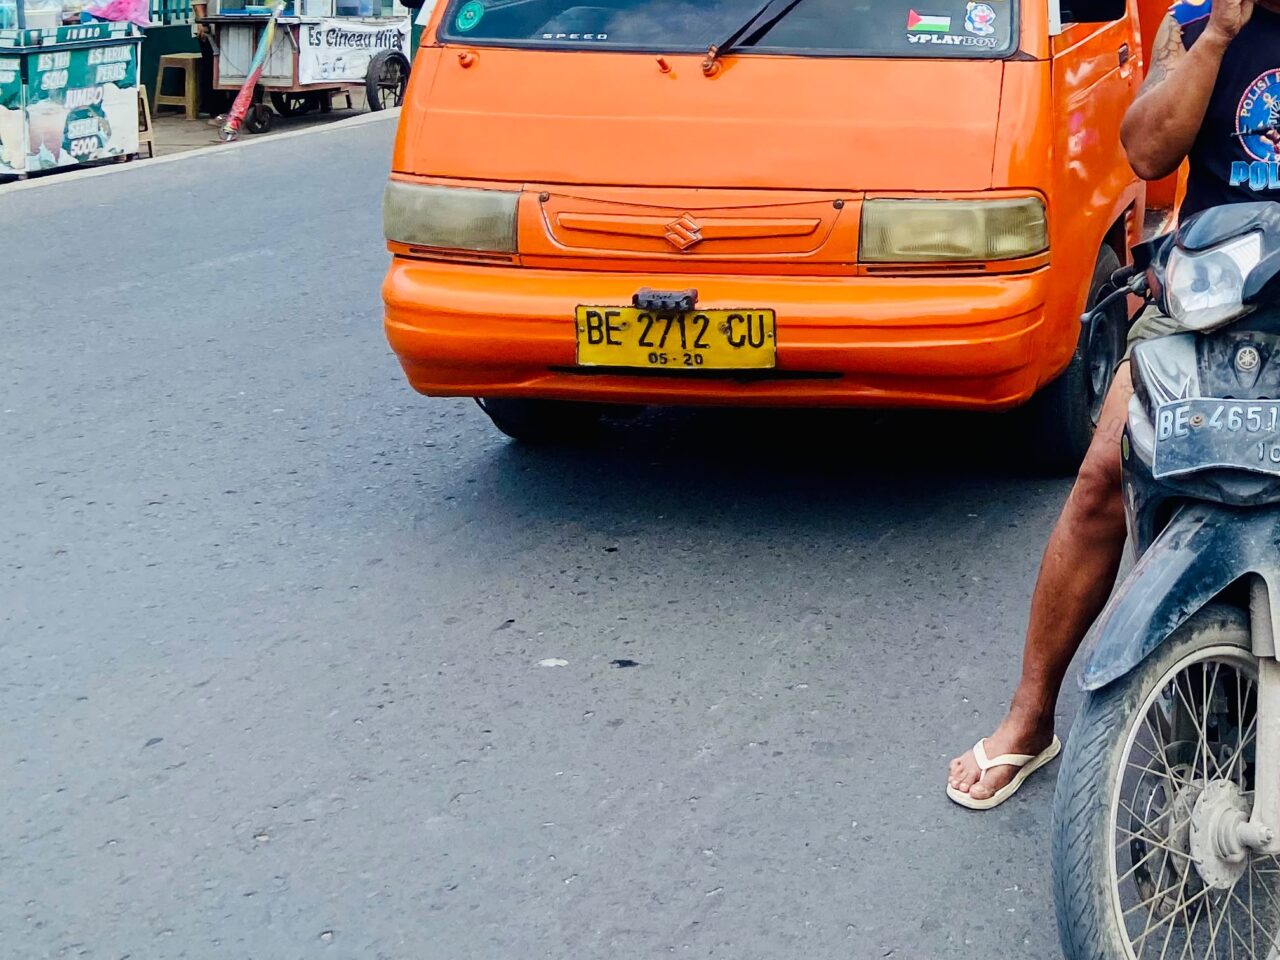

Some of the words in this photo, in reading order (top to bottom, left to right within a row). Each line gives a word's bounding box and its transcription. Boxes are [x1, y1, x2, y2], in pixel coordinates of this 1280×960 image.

[308, 26, 321, 47] Es
[326, 28, 371, 47] Cincau
[917, 34, 997, 47] PLAYBOY
[64, 87, 103, 109] JUMBO
[1241, 77, 1271, 117] POLISI
[70, 137, 98, 156] 5000
[586, 311, 622, 345] BE
[637, 311, 711, 349] 2712
[726, 313, 765, 348] CU
[1159, 406, 1190, 441] BE
[1209, 406, 1278, 433] 4651
